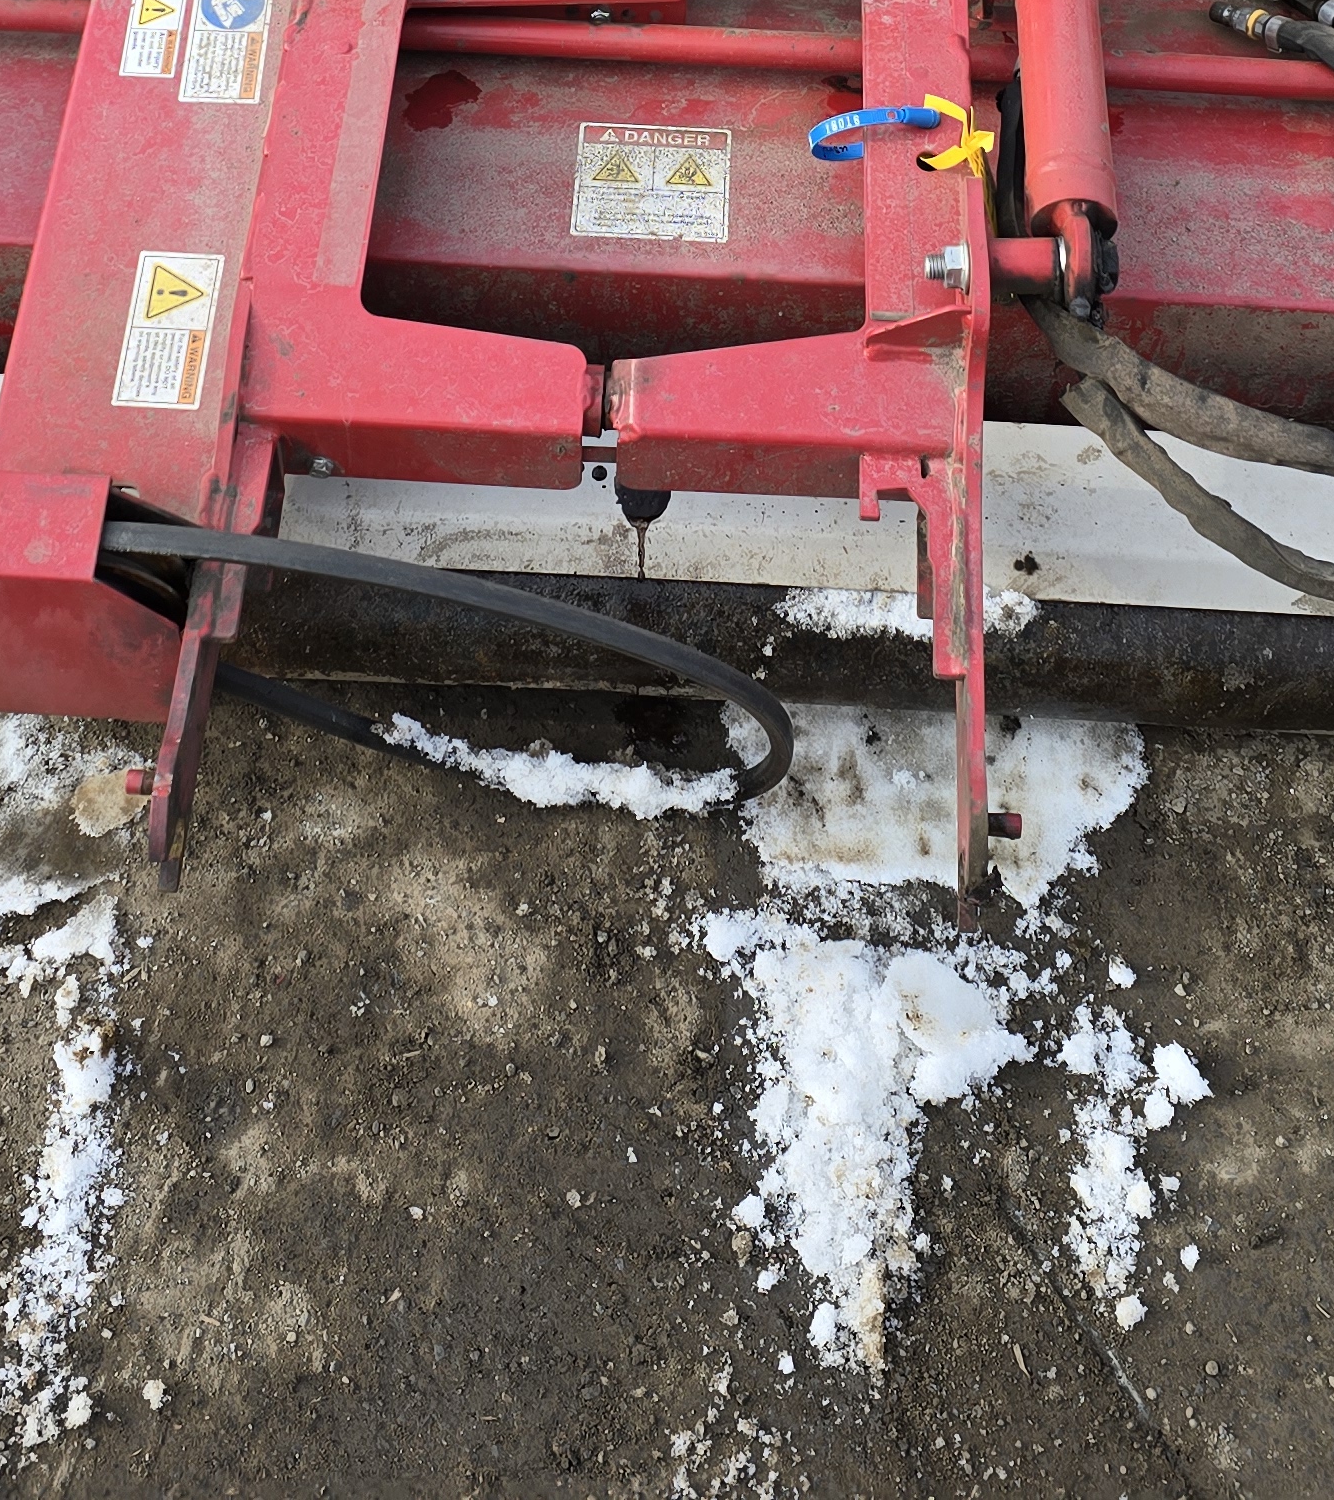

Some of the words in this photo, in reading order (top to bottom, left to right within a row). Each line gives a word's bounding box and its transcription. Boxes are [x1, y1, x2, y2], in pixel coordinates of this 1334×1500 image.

[243, 48, 258, 93] WARNING
[624, 130, 710, 146] DANGER
[181, 347, 200, 399] WARNING
